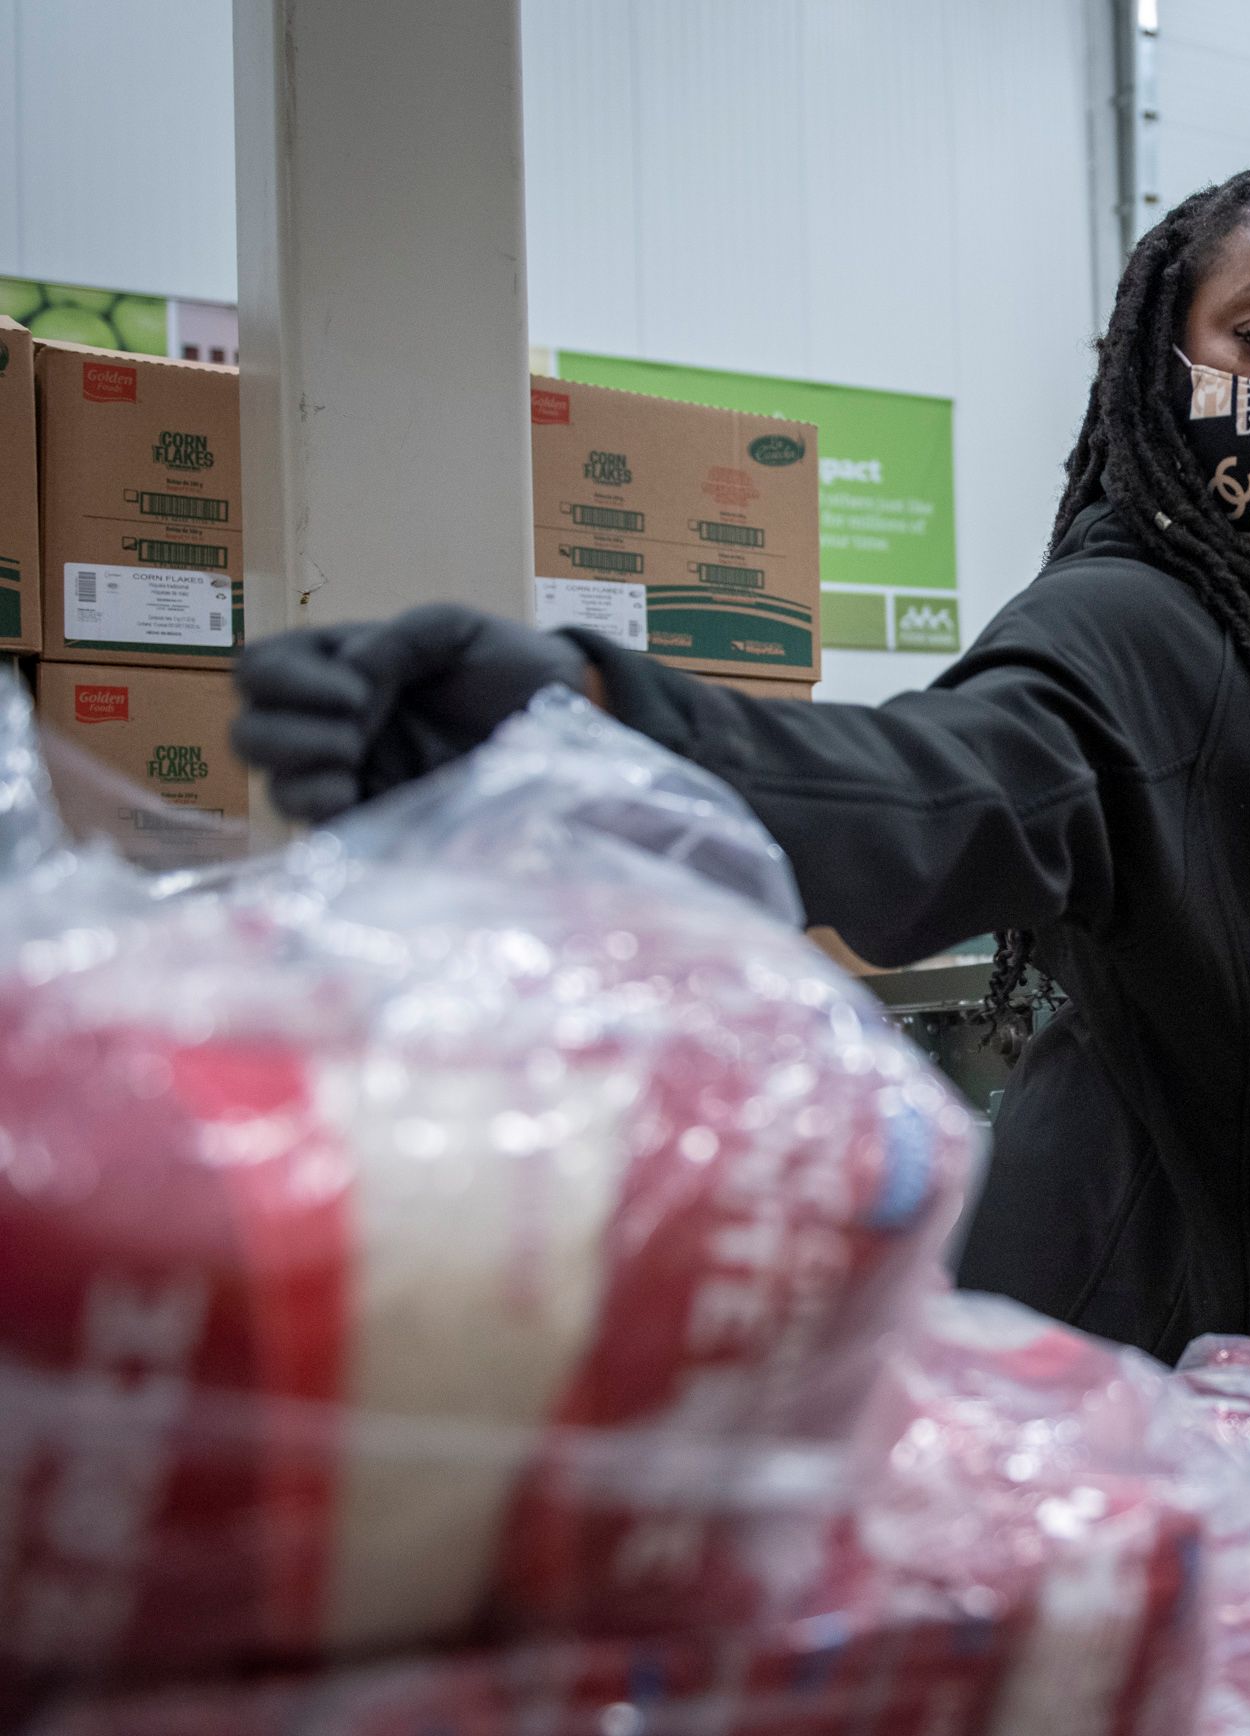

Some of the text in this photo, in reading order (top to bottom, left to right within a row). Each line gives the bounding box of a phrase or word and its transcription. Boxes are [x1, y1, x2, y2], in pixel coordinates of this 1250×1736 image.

[87, 368, 133, 386] Golden
[161, 431, 208, 452] CORN
[154, 444, 214, 468] FLAKES
[589, 450, 627, 468] CORN
[583, 463, 633, 484] FLAKES
[132, 572, 163, 582] CORN
[165, 575, 204, 585] FLAKES
[79, 691, 126, 704] Golden
[89, 703, 115, 713] Foods
[155, 745, 202, 762] CORN
[148, 760, 209, 778] FLAKES
